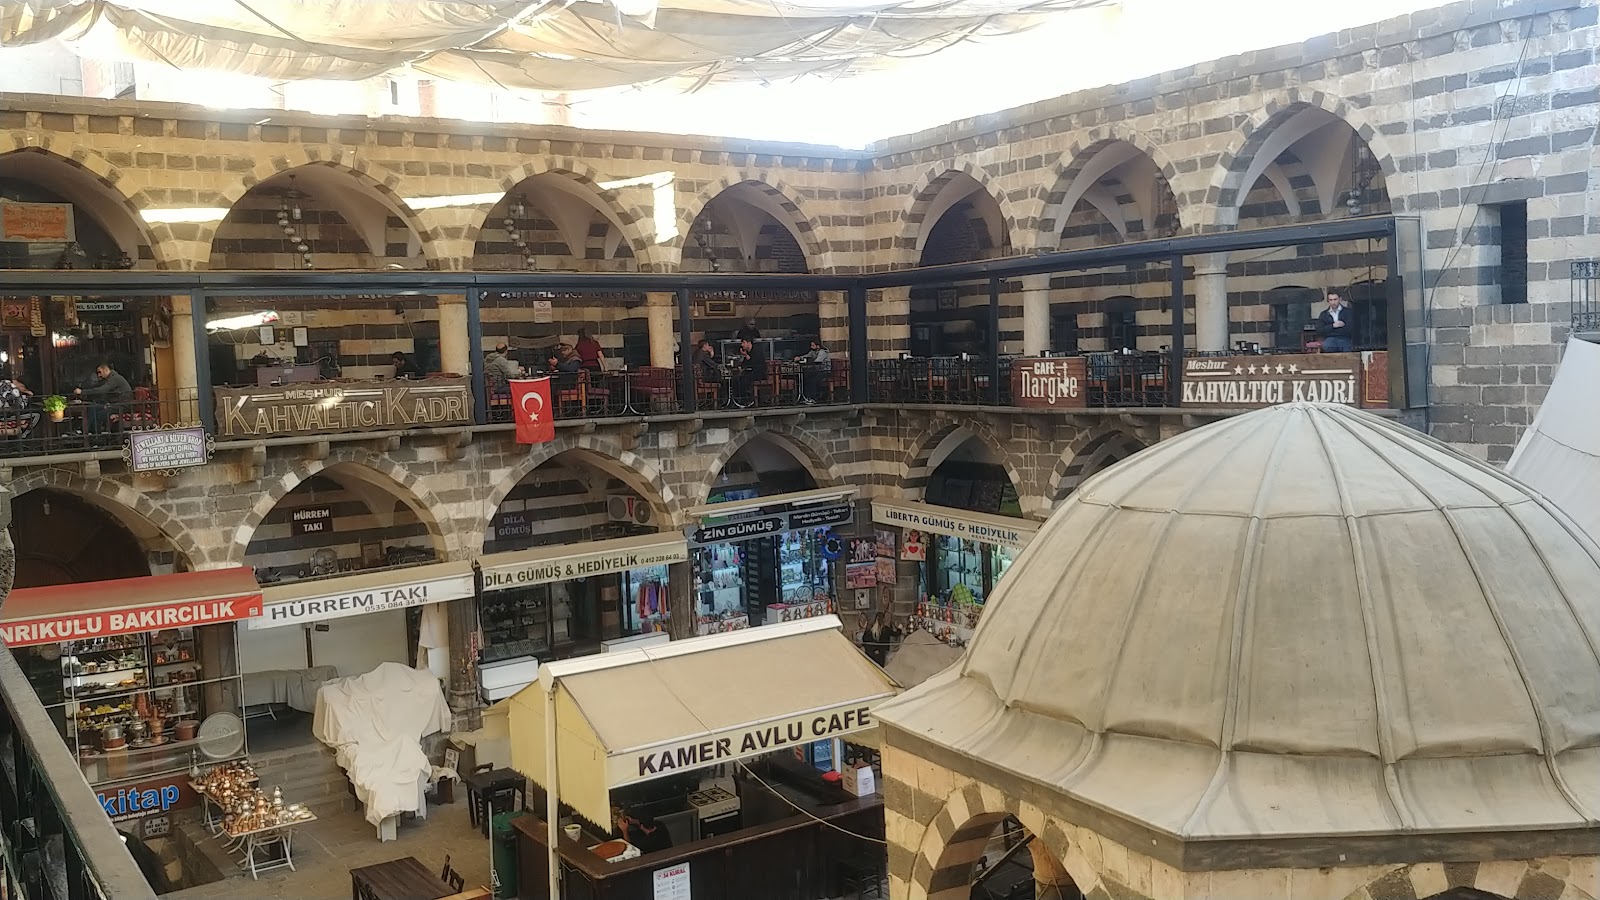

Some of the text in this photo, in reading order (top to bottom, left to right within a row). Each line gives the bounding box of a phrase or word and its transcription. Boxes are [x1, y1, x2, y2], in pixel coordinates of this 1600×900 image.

[1034, 362, 1055, 374] CAFE
[284, 388, 344, 400] MEŞHUR
[1182, 374, 1356, 403] KAHVALTICI KADRİ
[222, 387, 470, 436] KAHVALTICI KADRİ
[294, 509, 329, 520] HÜRREM
[503, 515, 525, 524] DİLA
[886, 508, 920, 523] LİBERTA
[922, 515, 955, 532] GÜMÜŞ
[968, 524, 1018, 541] HEDİYELİK
[303, 522, 323, 532] TAKI
[498, 525, 530, 536] GÜMÜŞ
[703, 521, 773, 539] ZİN GÜMÜŞ
[485, 572, 513, 586] DİLA
[517, 564, 561, 582] GÜMÜŞ
[565, 564, 573, 576] &
[578, 553, 638, 573] HEDİYELİK
[272, 594, 373, 620] HÜRREM
[380, 586, 427, 603] TAKI
[365, 604, 386, 612] 0535
[109, 601, 235, 631] BAKIRCILIK
[639, 706, 870, 776] KAMER AVLU CAFE
[97, 784, 180, 816] kitap
